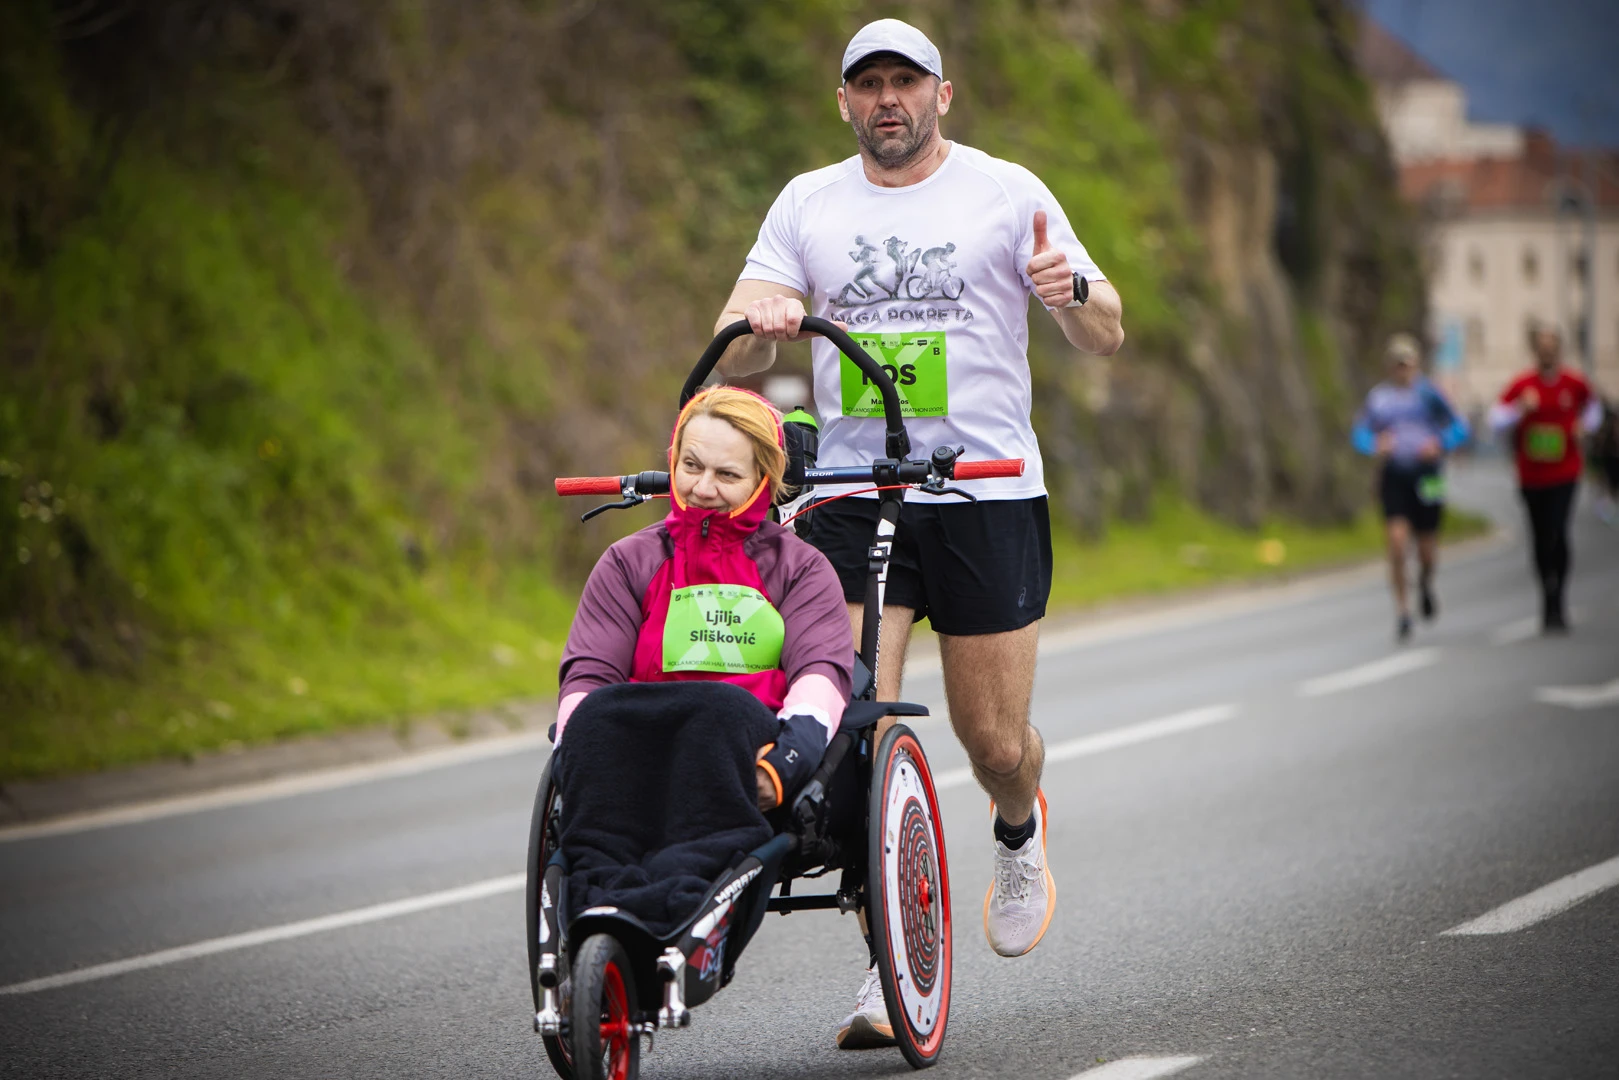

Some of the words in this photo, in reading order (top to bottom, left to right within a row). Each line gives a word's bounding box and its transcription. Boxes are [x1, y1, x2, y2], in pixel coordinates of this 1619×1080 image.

[887, 308, 975, 322] POKRETA
[933, 347, 940, 355] B
[706, 610, 741, 626] Ljilja
[690, 629, 756, 645] Slišković
[727, 662, 760, 670] MARATHON
